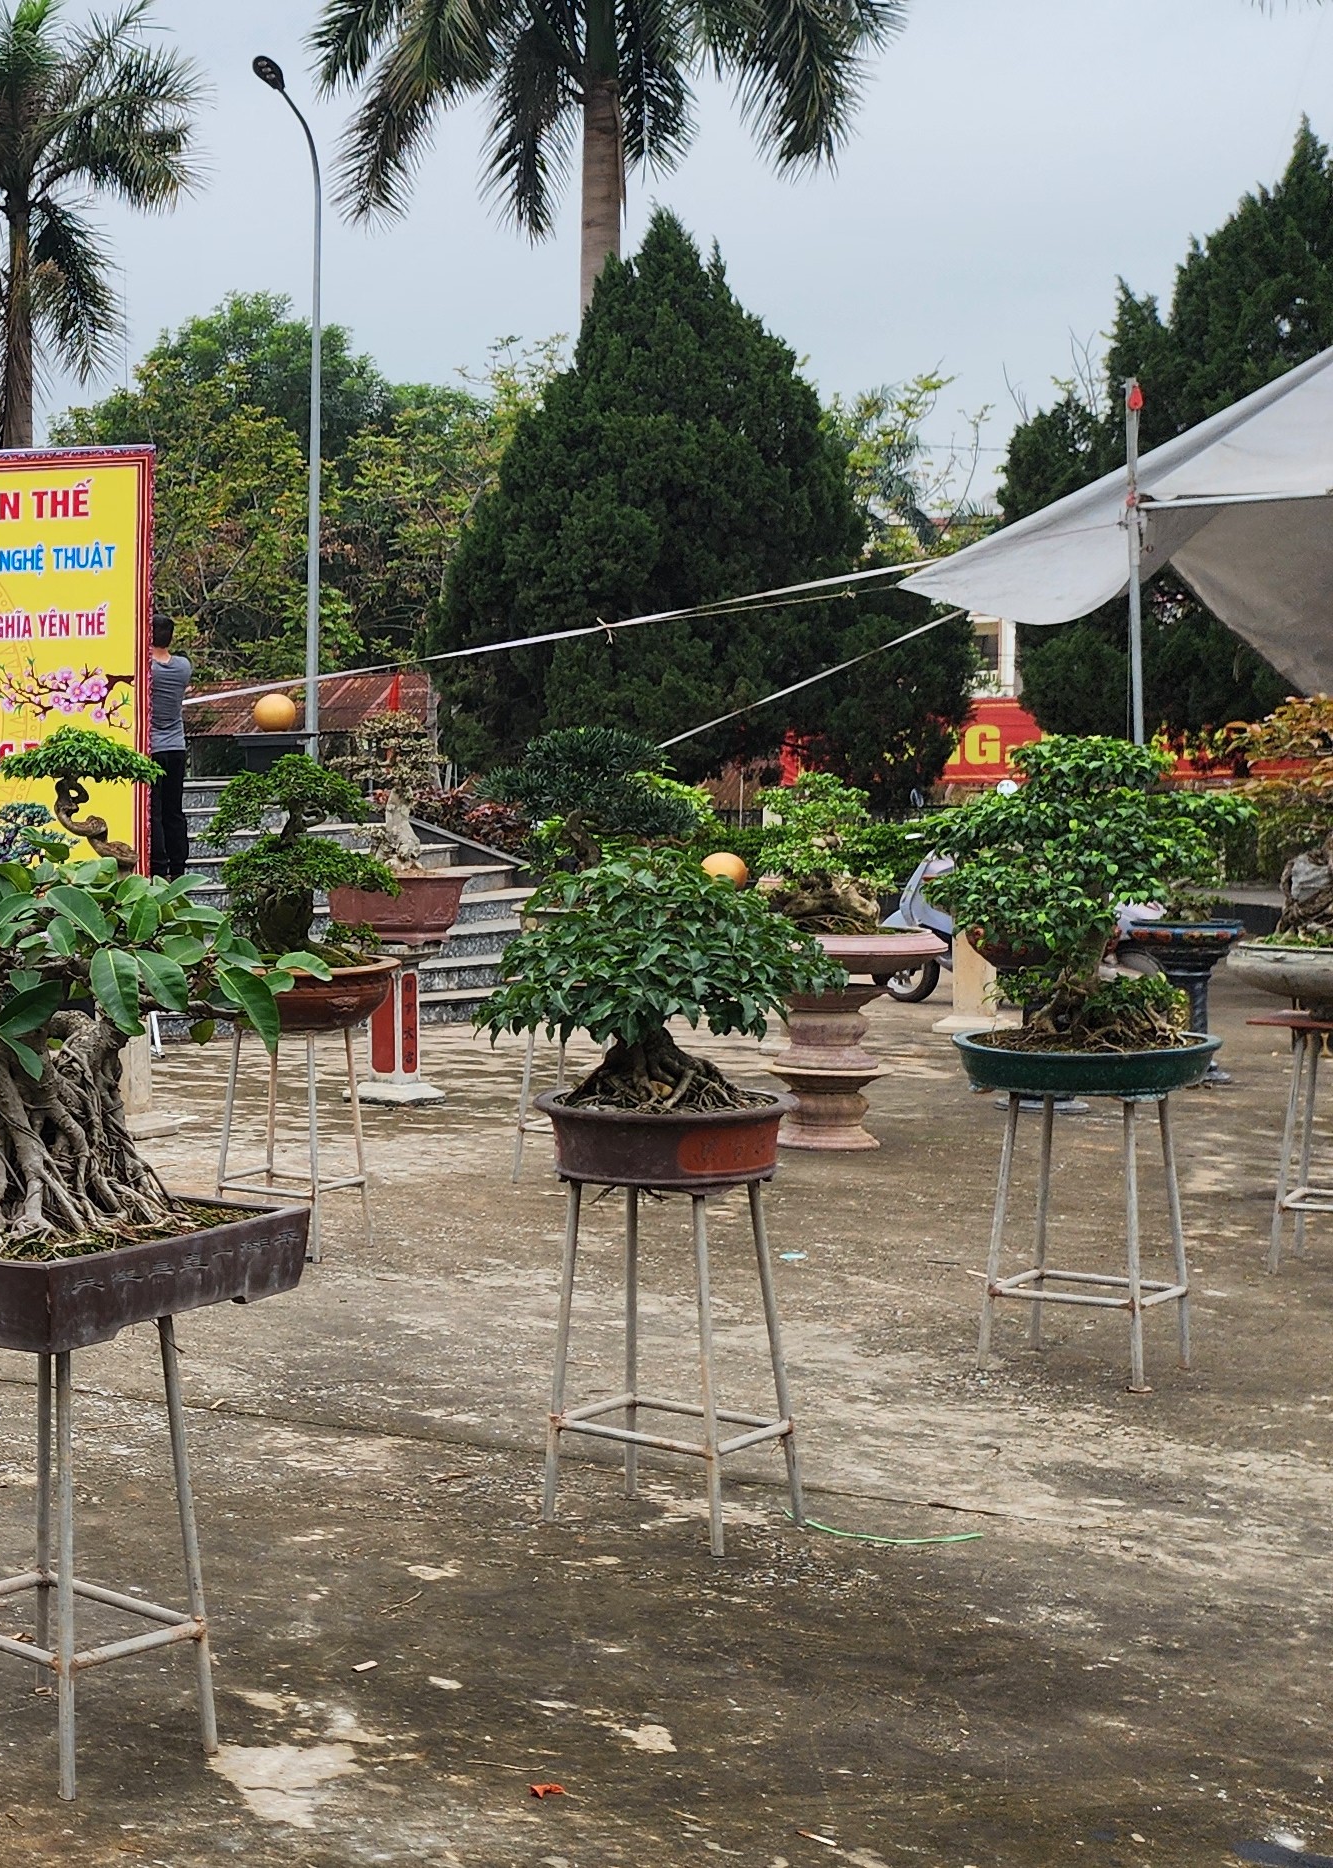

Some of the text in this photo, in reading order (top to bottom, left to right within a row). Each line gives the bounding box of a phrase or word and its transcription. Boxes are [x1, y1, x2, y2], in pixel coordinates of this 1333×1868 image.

[32, 478, 92, 519] THẾ
[53, 541, 115, 574] THUẬT
[38, 609, 70, 637] YÊN
[75, 603, 108, 636] THẾ
